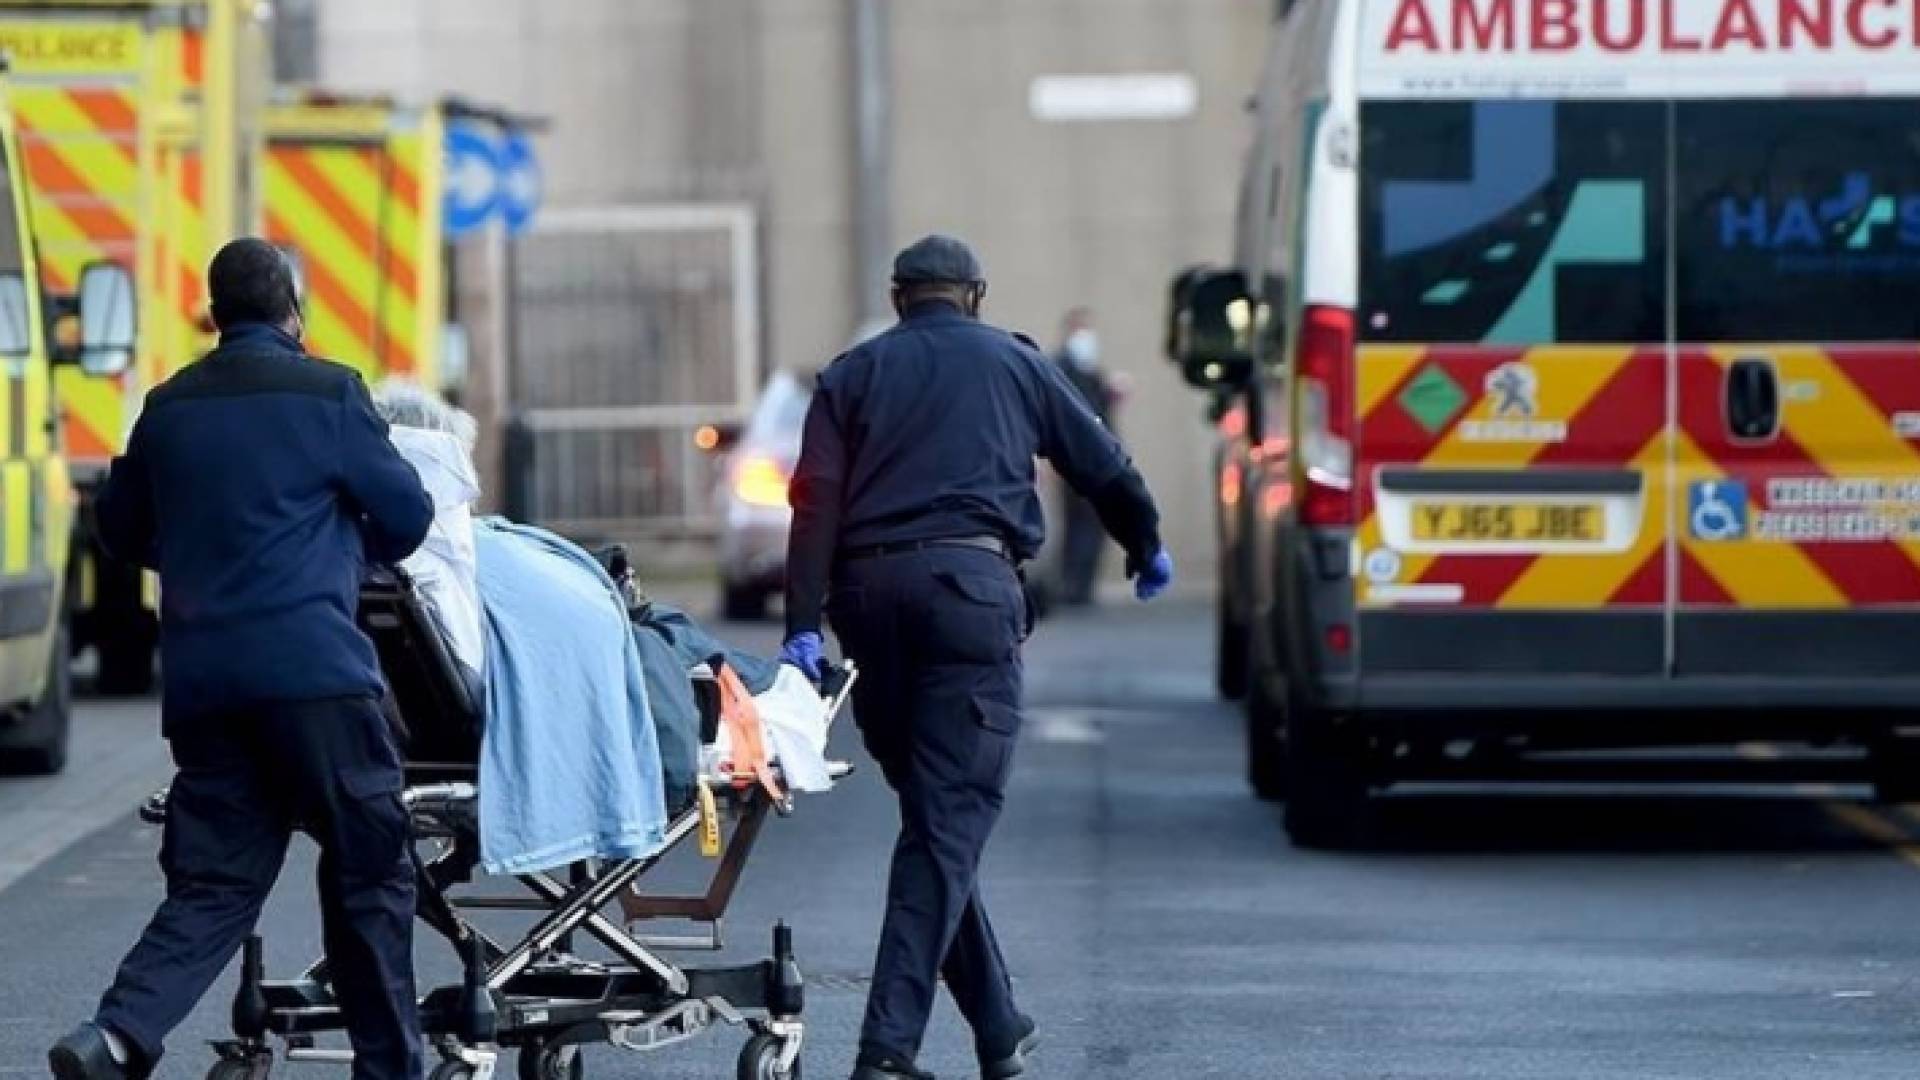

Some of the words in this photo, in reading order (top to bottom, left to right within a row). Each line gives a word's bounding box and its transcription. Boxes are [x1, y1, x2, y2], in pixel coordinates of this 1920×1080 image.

[1384, 0, 1920, 52] AMBULANC
[1423, 504, 1514, 540] YJ65
[1523, 504, 1592, 540] JBE
